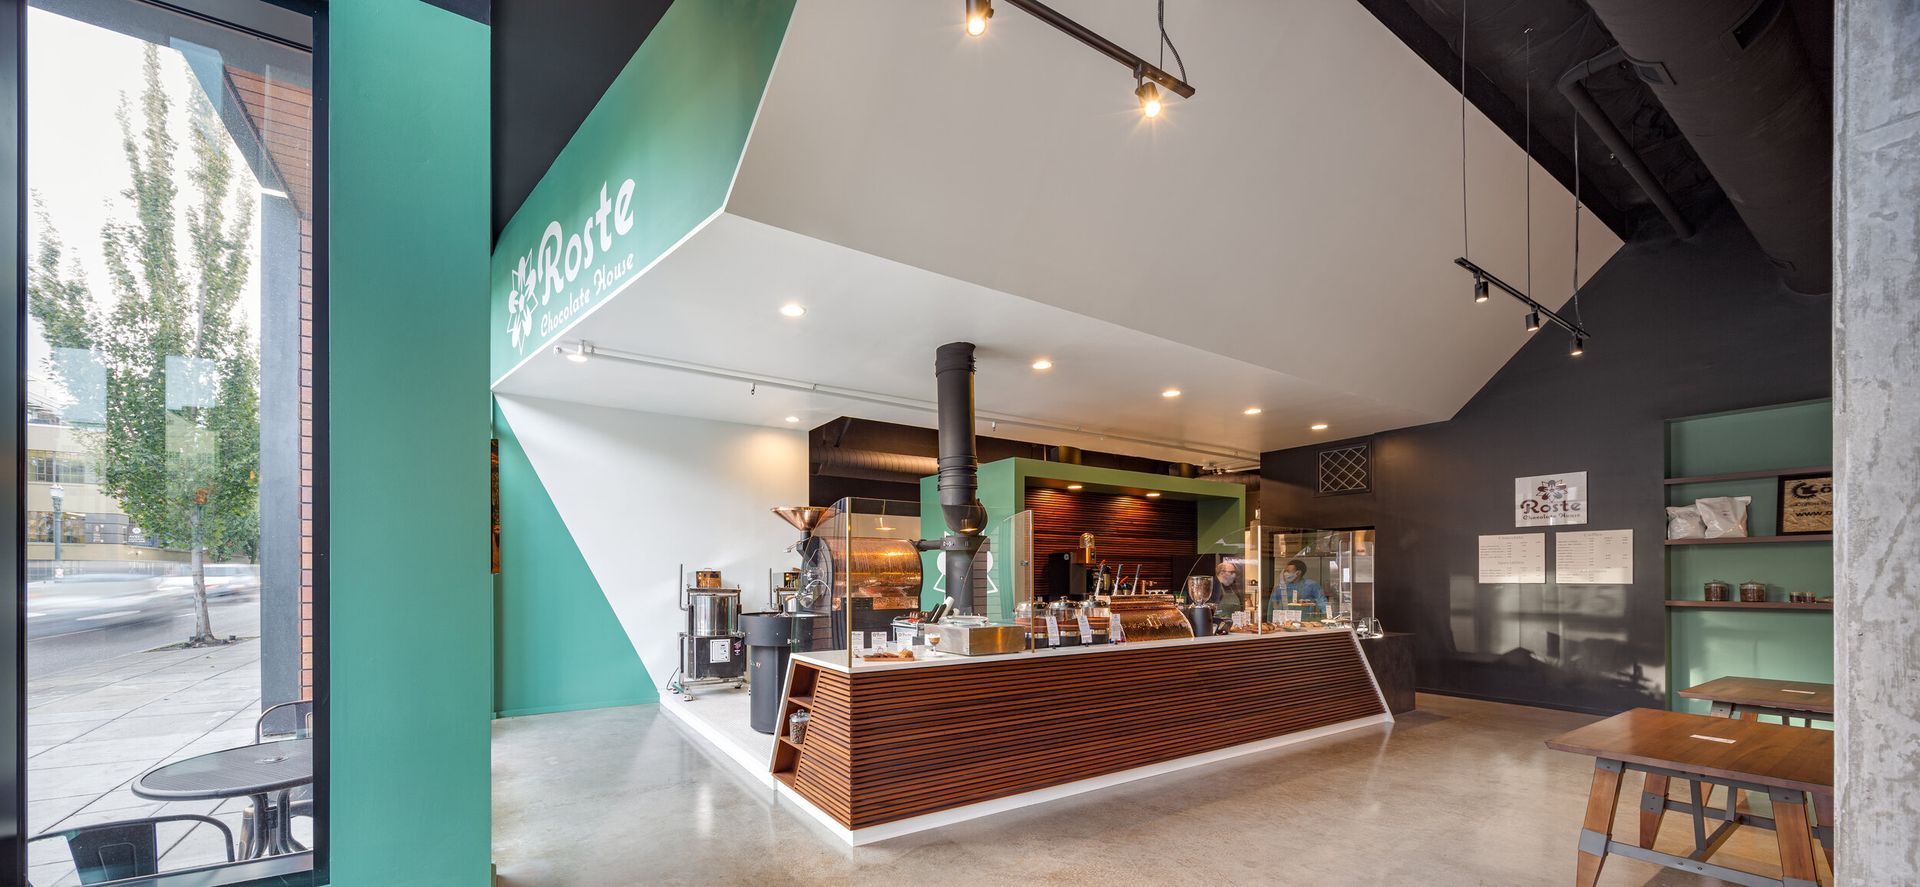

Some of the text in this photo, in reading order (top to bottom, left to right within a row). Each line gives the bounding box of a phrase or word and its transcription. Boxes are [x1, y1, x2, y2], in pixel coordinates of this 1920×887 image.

[538, 179, 636, 306] Roste
[540, 253, 634, 337] Chocolate House
[1520, 499, 1582, 514] Roste
